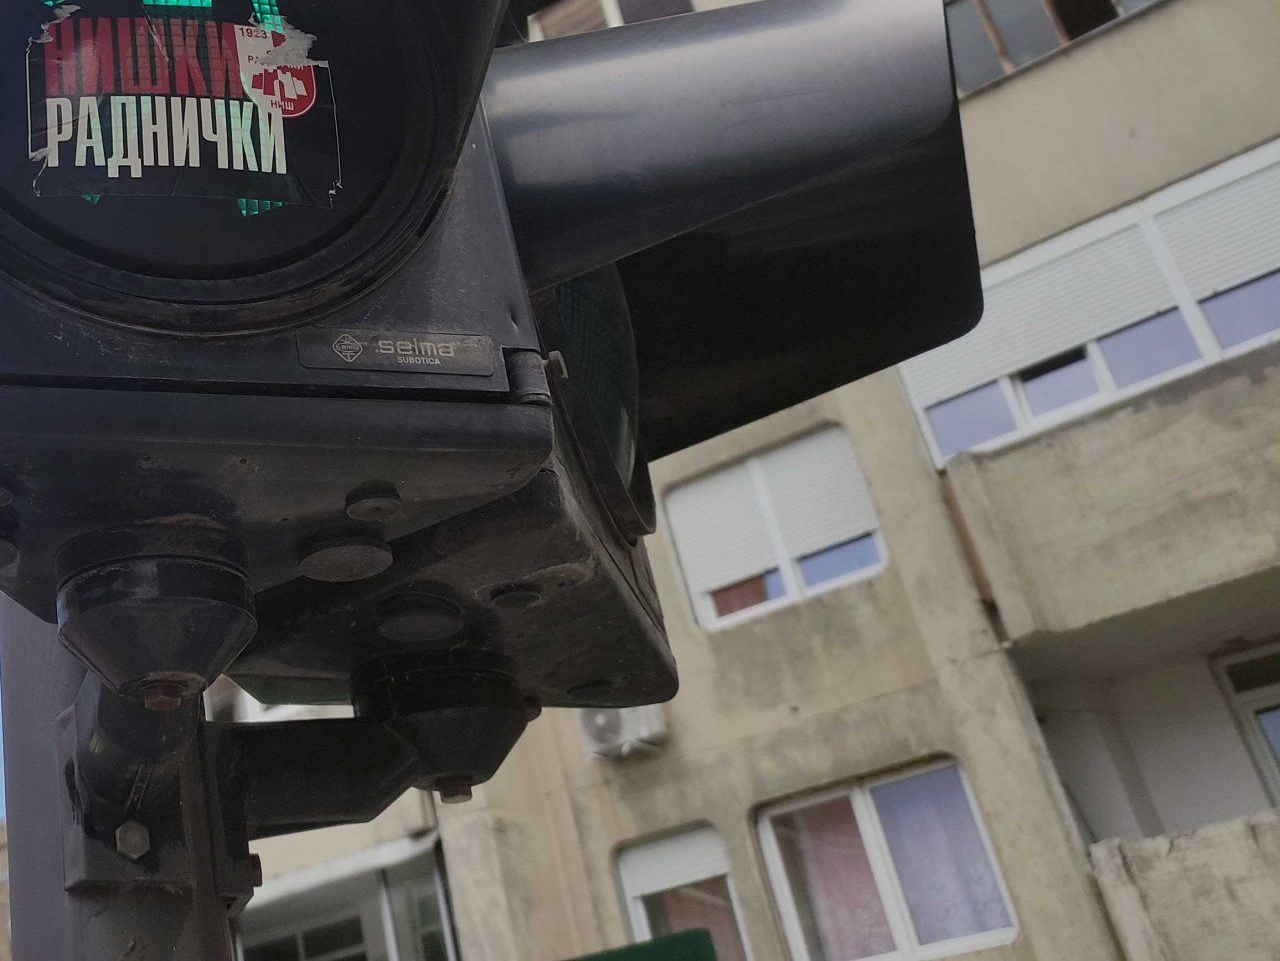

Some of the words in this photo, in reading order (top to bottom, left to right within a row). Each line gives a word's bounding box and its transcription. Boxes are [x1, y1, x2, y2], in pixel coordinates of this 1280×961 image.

[239, 26, 268, 40] 1923
[44, 17, 245, 98] НИШКИ
[270, 99, 295, 111] НИШ
[45, 95, 288, 178] РАДНИЧКИ
[377, 337, 456, 358] selma
[396, 355, 441, 365] SUBOTICA
